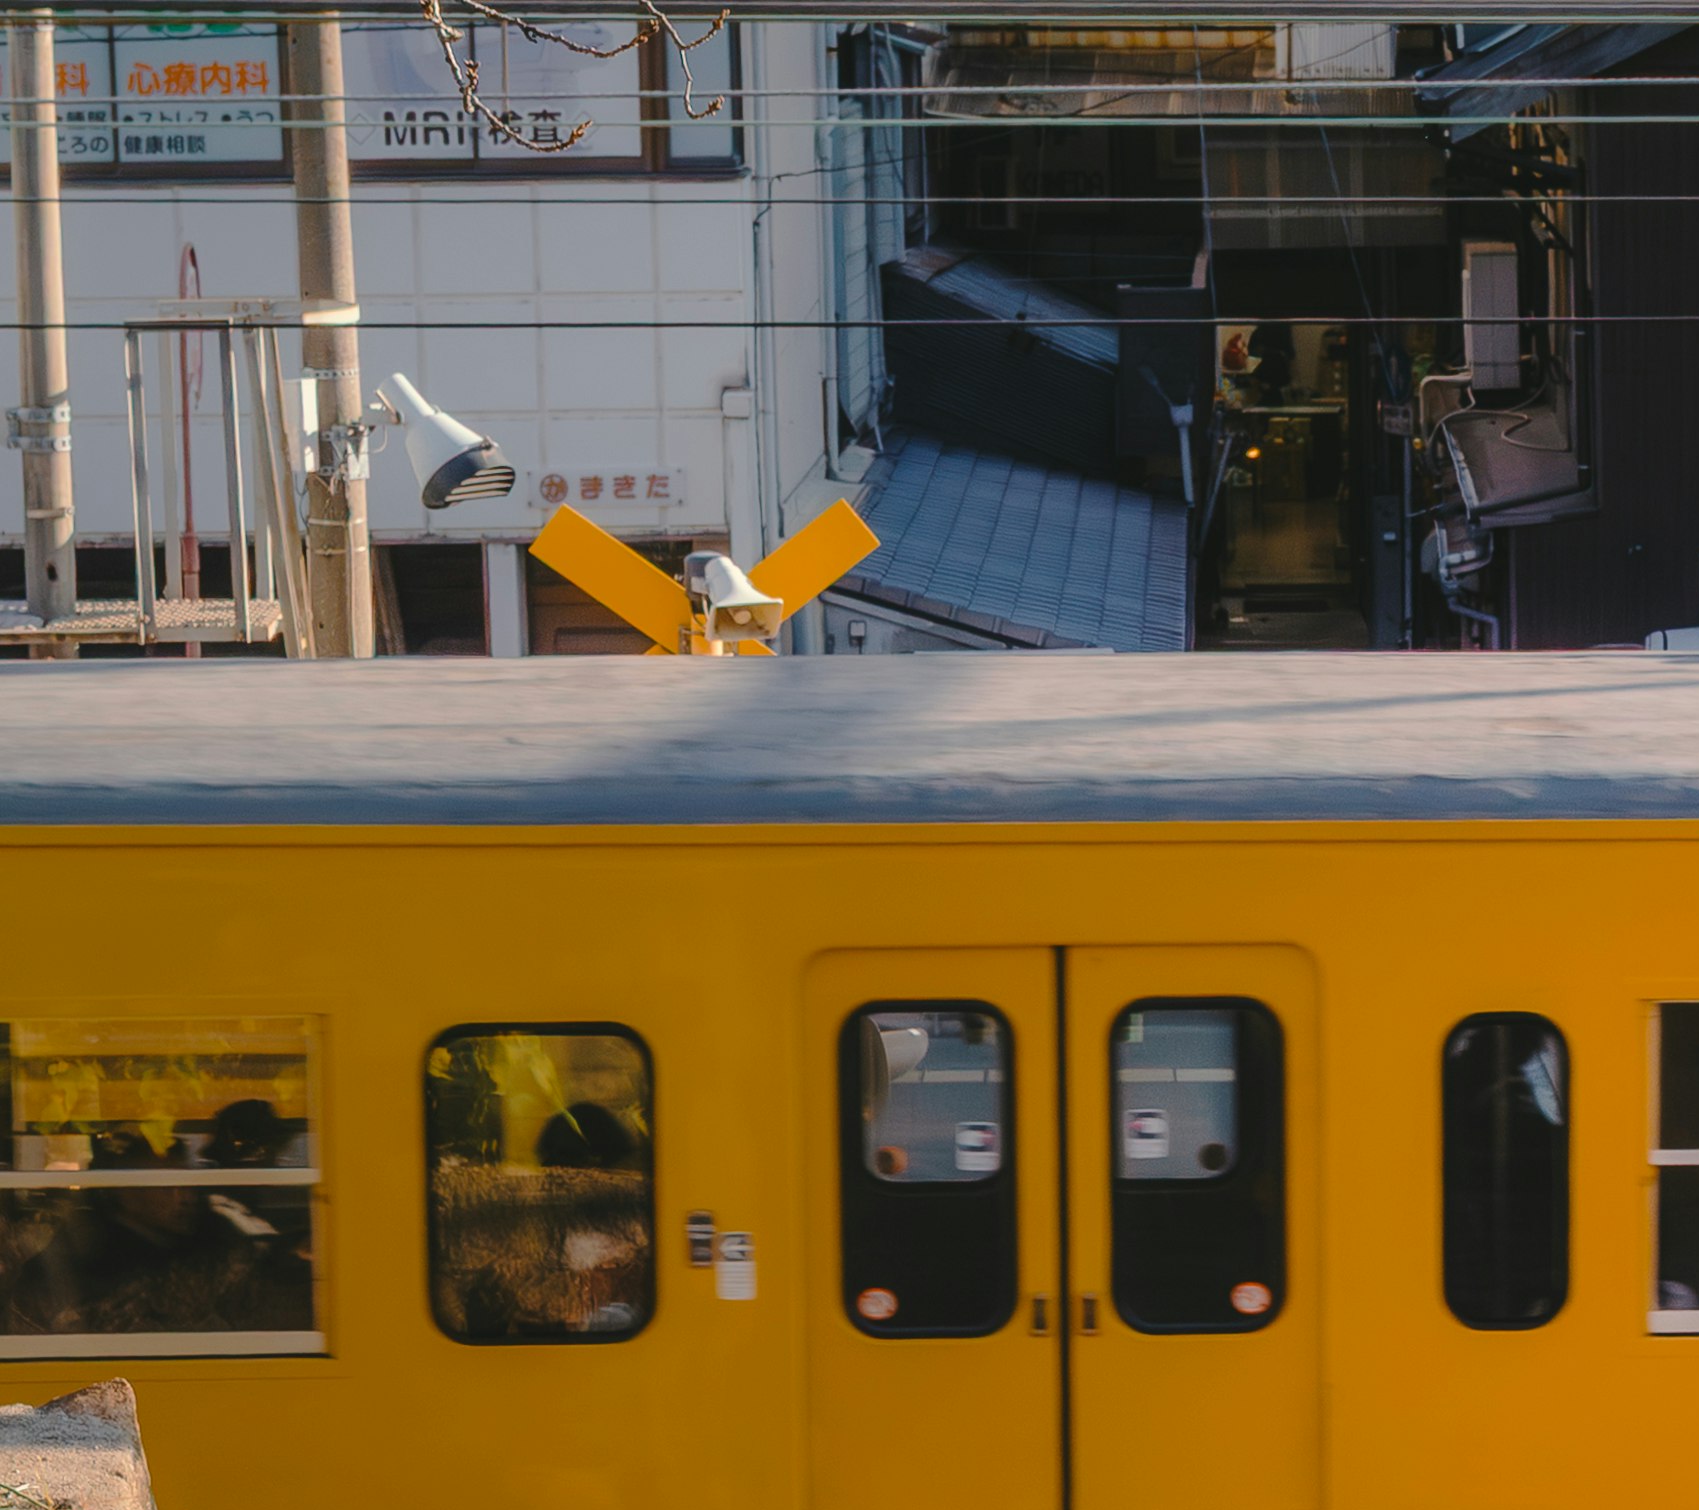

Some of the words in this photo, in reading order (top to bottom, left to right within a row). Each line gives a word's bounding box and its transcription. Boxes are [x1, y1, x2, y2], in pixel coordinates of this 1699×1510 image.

[127, 61, 270, 95] 心療内科
[124, 135, 207, 155] 健康相談
